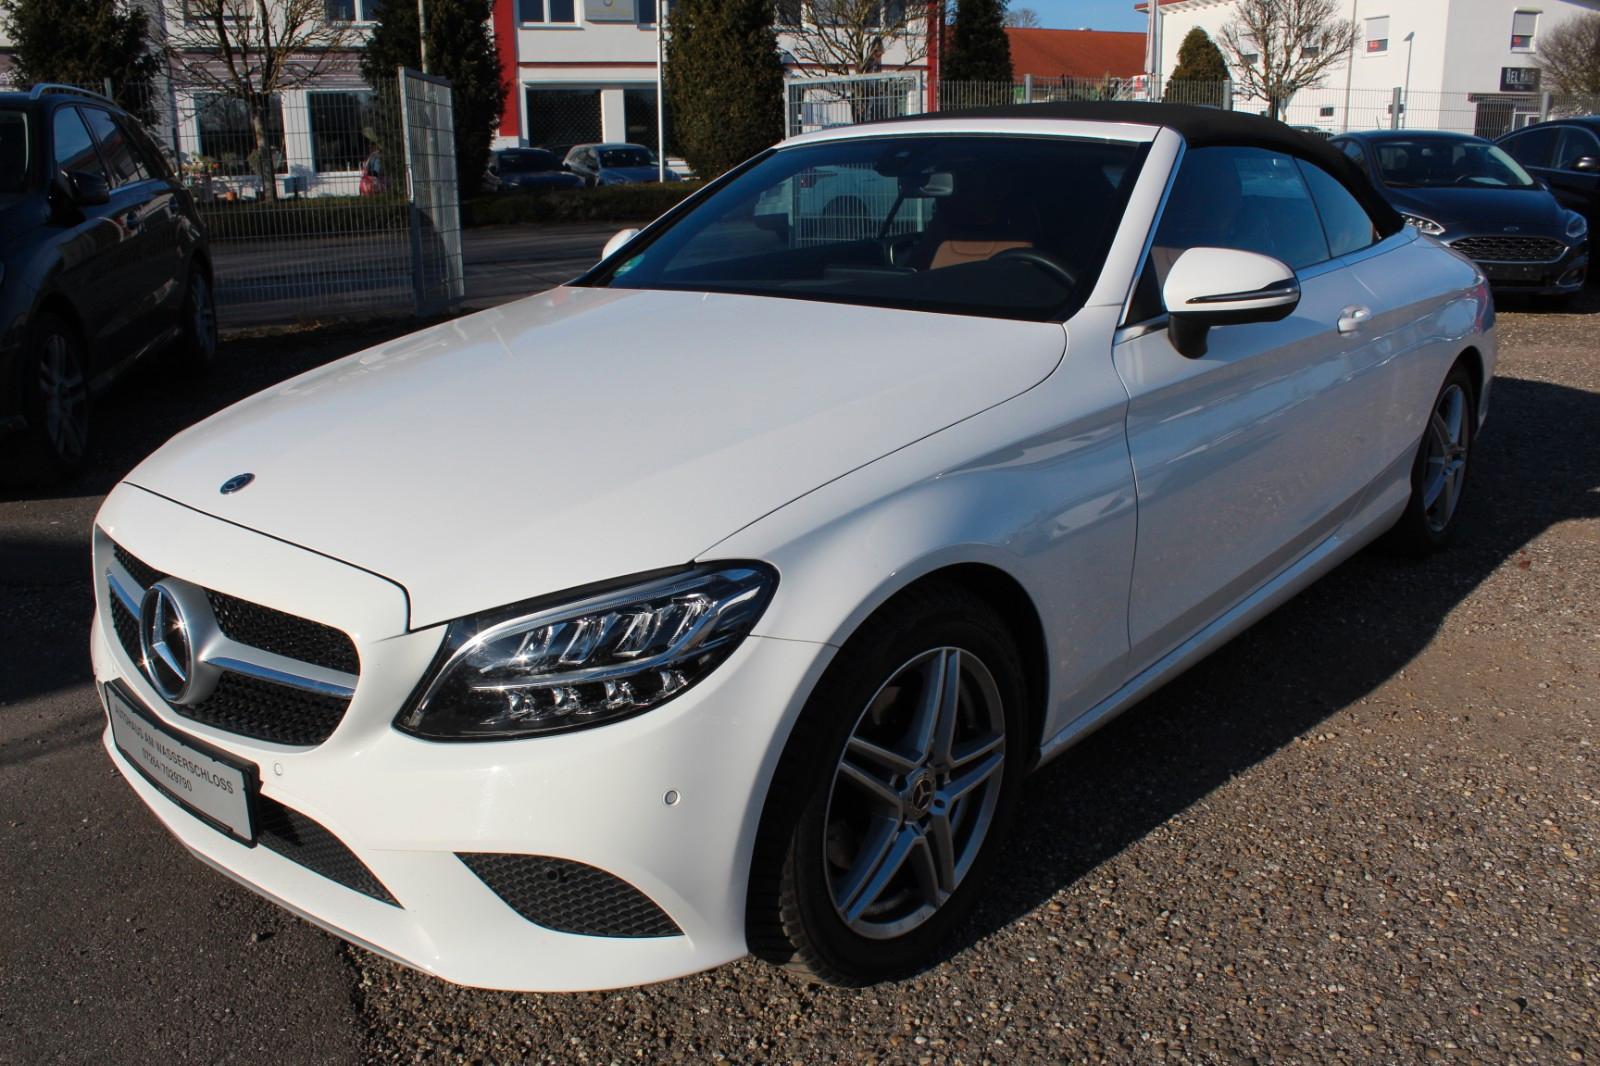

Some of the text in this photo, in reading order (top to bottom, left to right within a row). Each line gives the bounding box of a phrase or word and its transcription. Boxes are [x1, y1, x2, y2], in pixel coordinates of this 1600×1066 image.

[115, 704, 234, 794] AUTOHAUS AM WASSERSCHLOSS
